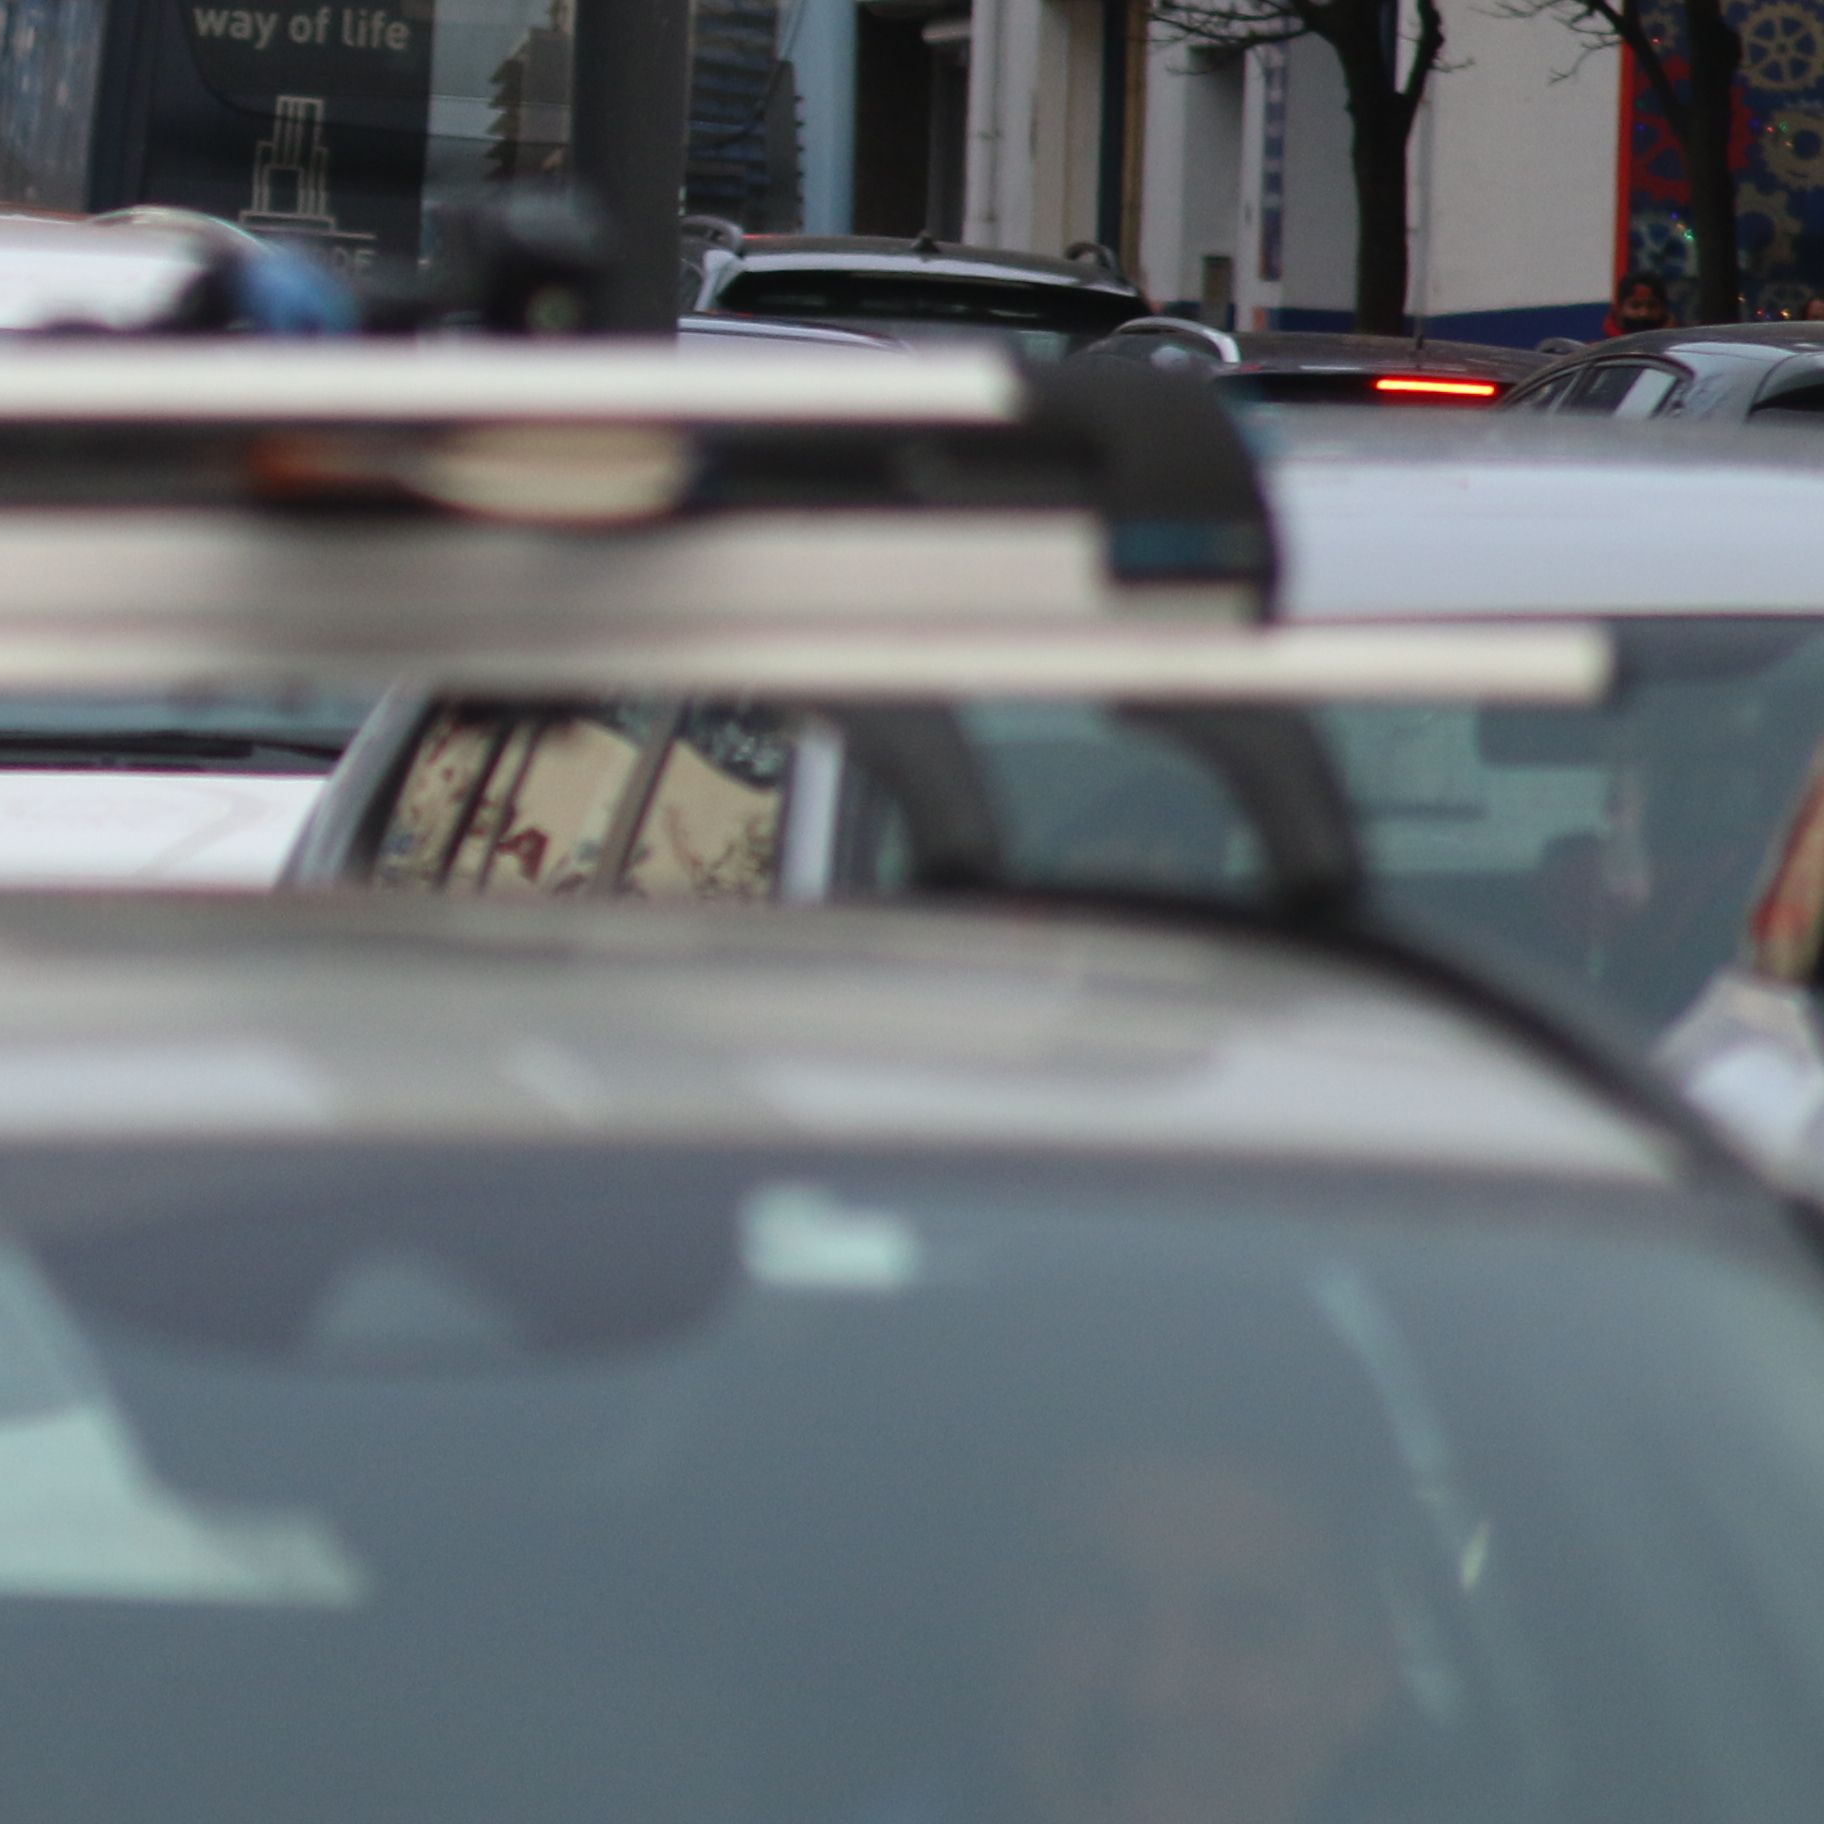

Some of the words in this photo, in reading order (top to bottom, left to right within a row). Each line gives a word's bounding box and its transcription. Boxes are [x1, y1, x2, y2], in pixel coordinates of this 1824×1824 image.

[193, 8, 279, 50] way
[288, 6, 331, 44] of
[341, 8, 411, 51] life
